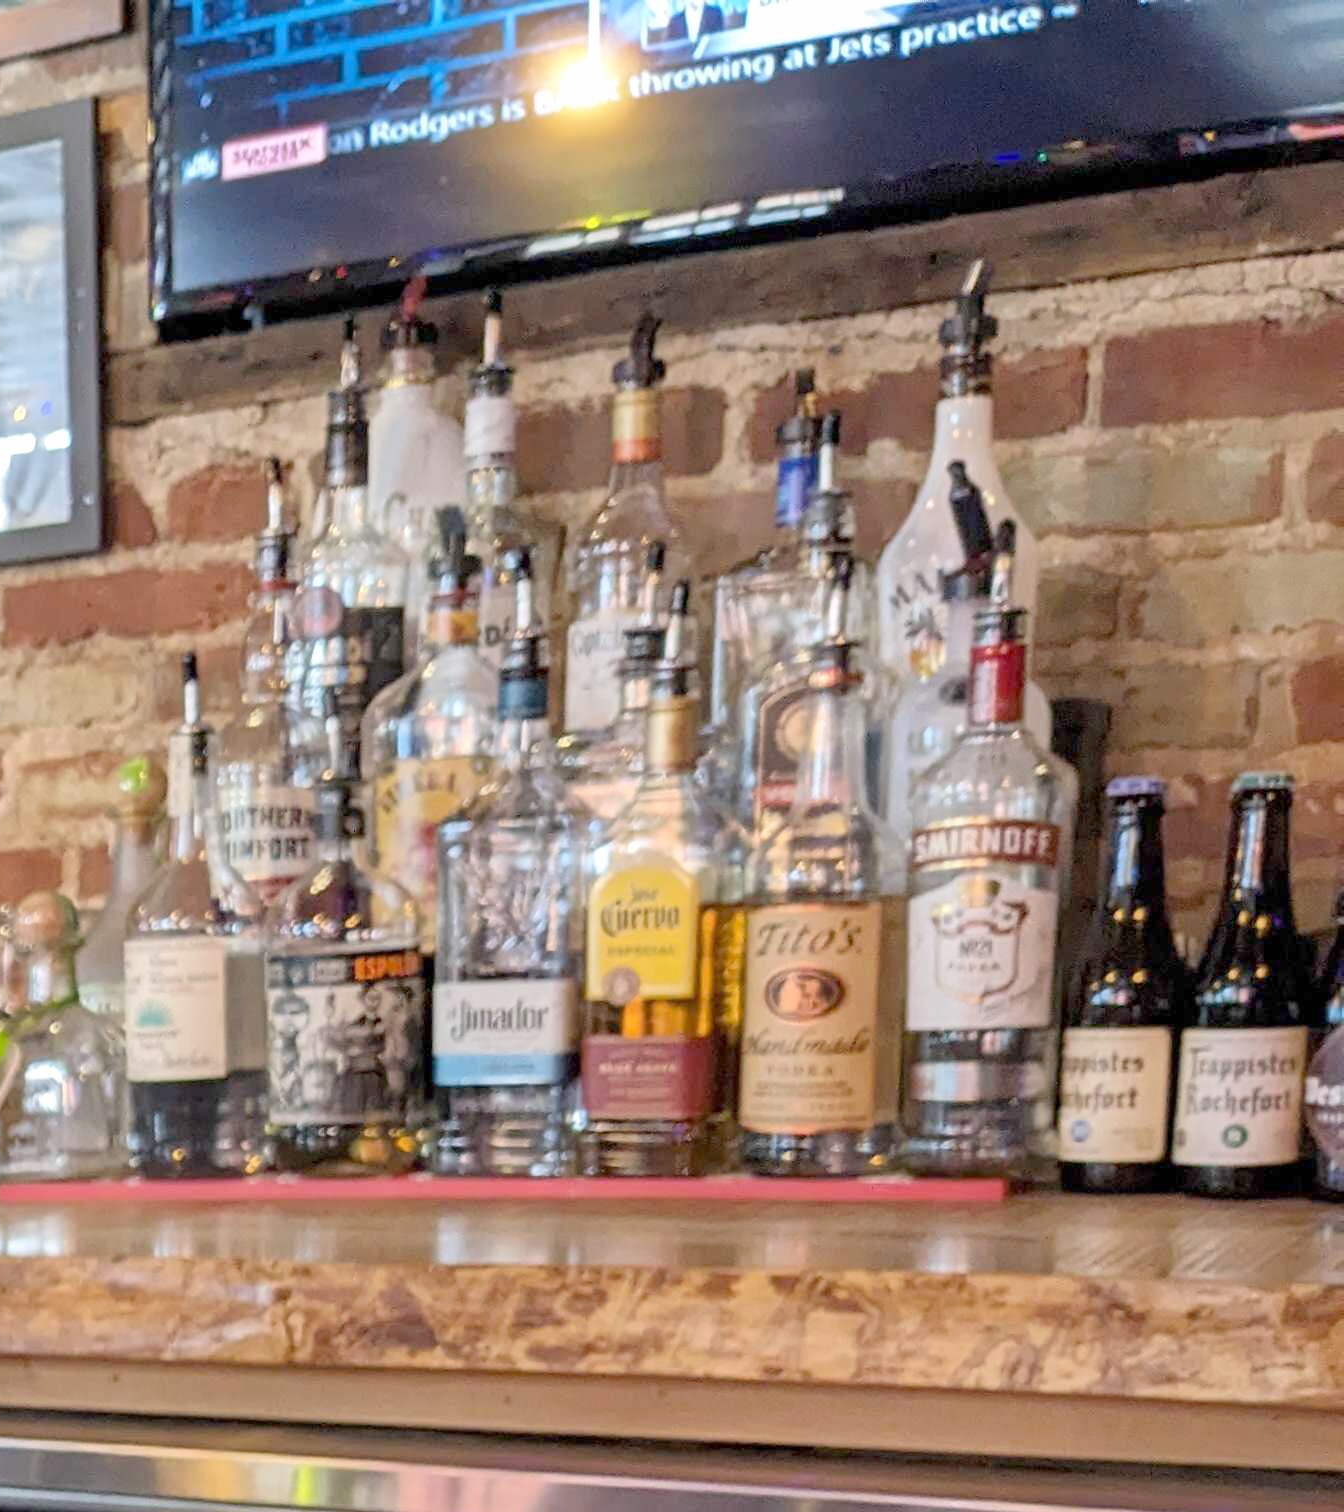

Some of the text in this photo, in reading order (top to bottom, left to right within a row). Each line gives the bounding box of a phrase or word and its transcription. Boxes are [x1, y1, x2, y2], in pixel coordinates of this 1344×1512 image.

[369, 102, 495, 148] Rodgers
[501, 99, 526, 122] is
[629, 52, 775, 98] throwing
[785, 47, 817, 71] at
[826, 33, 892, 66] Jets
[900, 4, 1042, 57] practice
[913, 826, 1054, 864] SMIRNOFF
[599, 899, 681, 938] Cuervo
